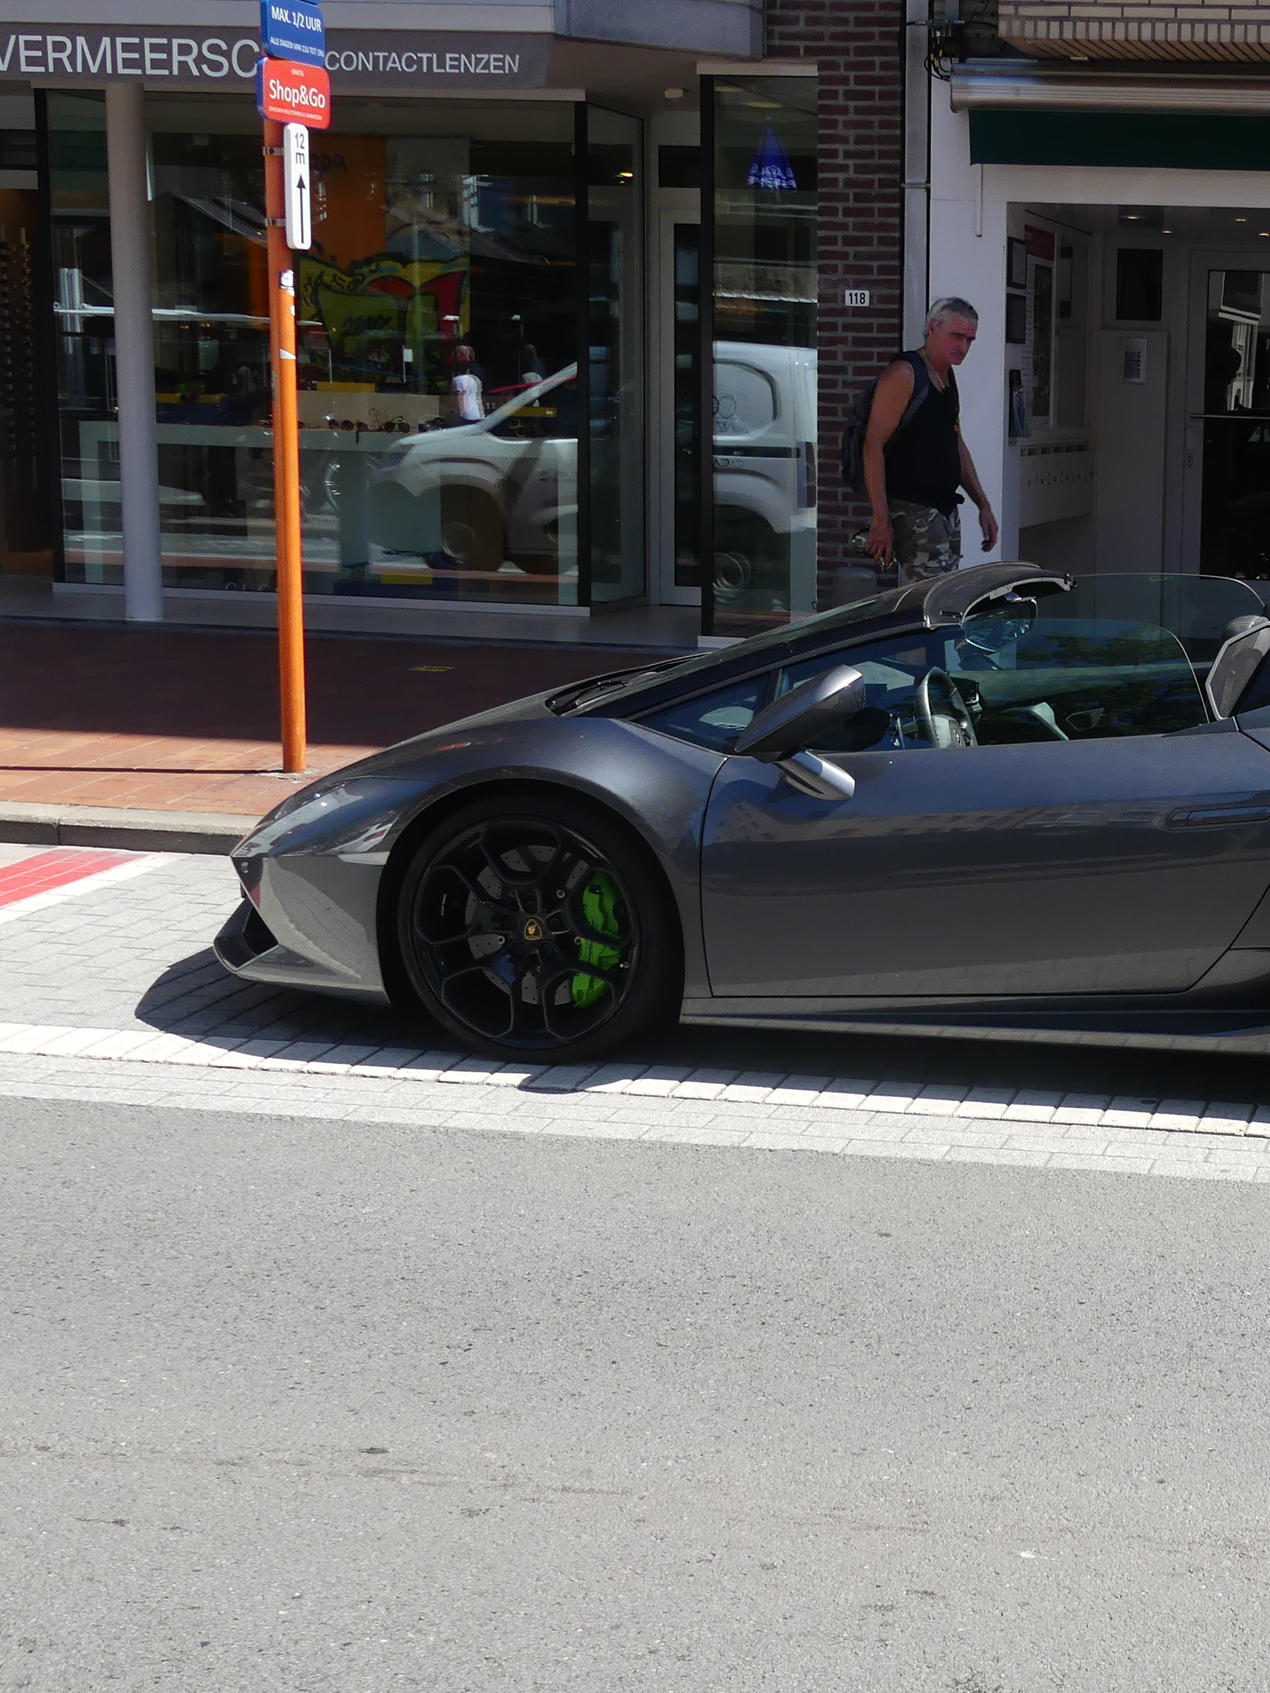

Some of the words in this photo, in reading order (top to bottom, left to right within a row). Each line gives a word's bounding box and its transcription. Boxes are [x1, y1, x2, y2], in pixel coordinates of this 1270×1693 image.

[271, 6, 291, 25] MAX.
[292, 11, 305, 28] 1/2
[305, 16, 322, 32] UUR
[0, 34, 260, 78] VERMEERSC
[325, 51, 519, 74] CONTACTLENZEN
[269, 79, 326, 109] Shop&Go
[294, 133, 305, 150] 12
[295, 151, 305, 165] m
[848, 292, 866, 305] 118
